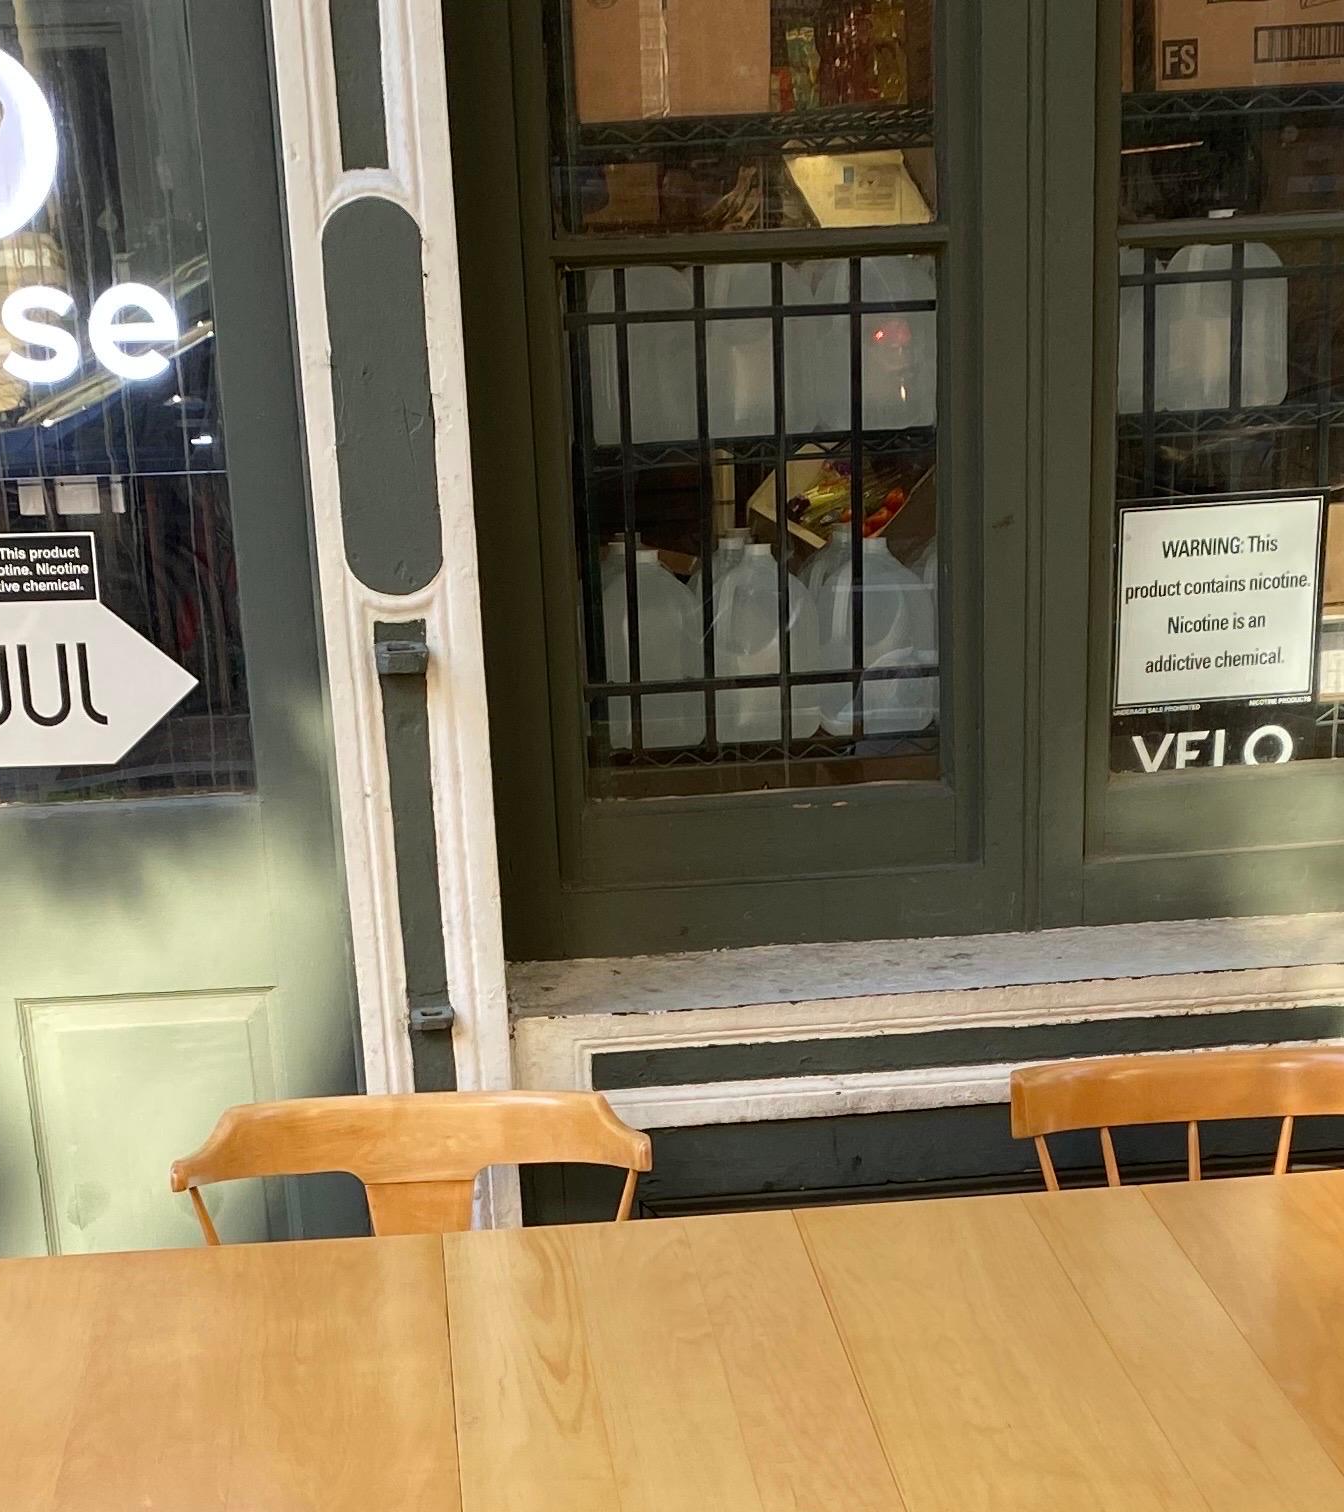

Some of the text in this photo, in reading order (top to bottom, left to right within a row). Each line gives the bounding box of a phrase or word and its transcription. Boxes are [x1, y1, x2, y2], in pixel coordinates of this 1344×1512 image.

[1164, 43, 1197, 77] FS
[29, 546, 80, 562] product
[1162, 533, 1278, 558] WARNING: This
[35, 562, 89, 576] Nicotine
[22, 578, 84, 593] chemical.
[1125, 570, 1311, 605] product contains nicotine.
[1167, 611, 1266, 635] Nicotine is an
[1145, 646, 1284, 674] addictive chemical.
